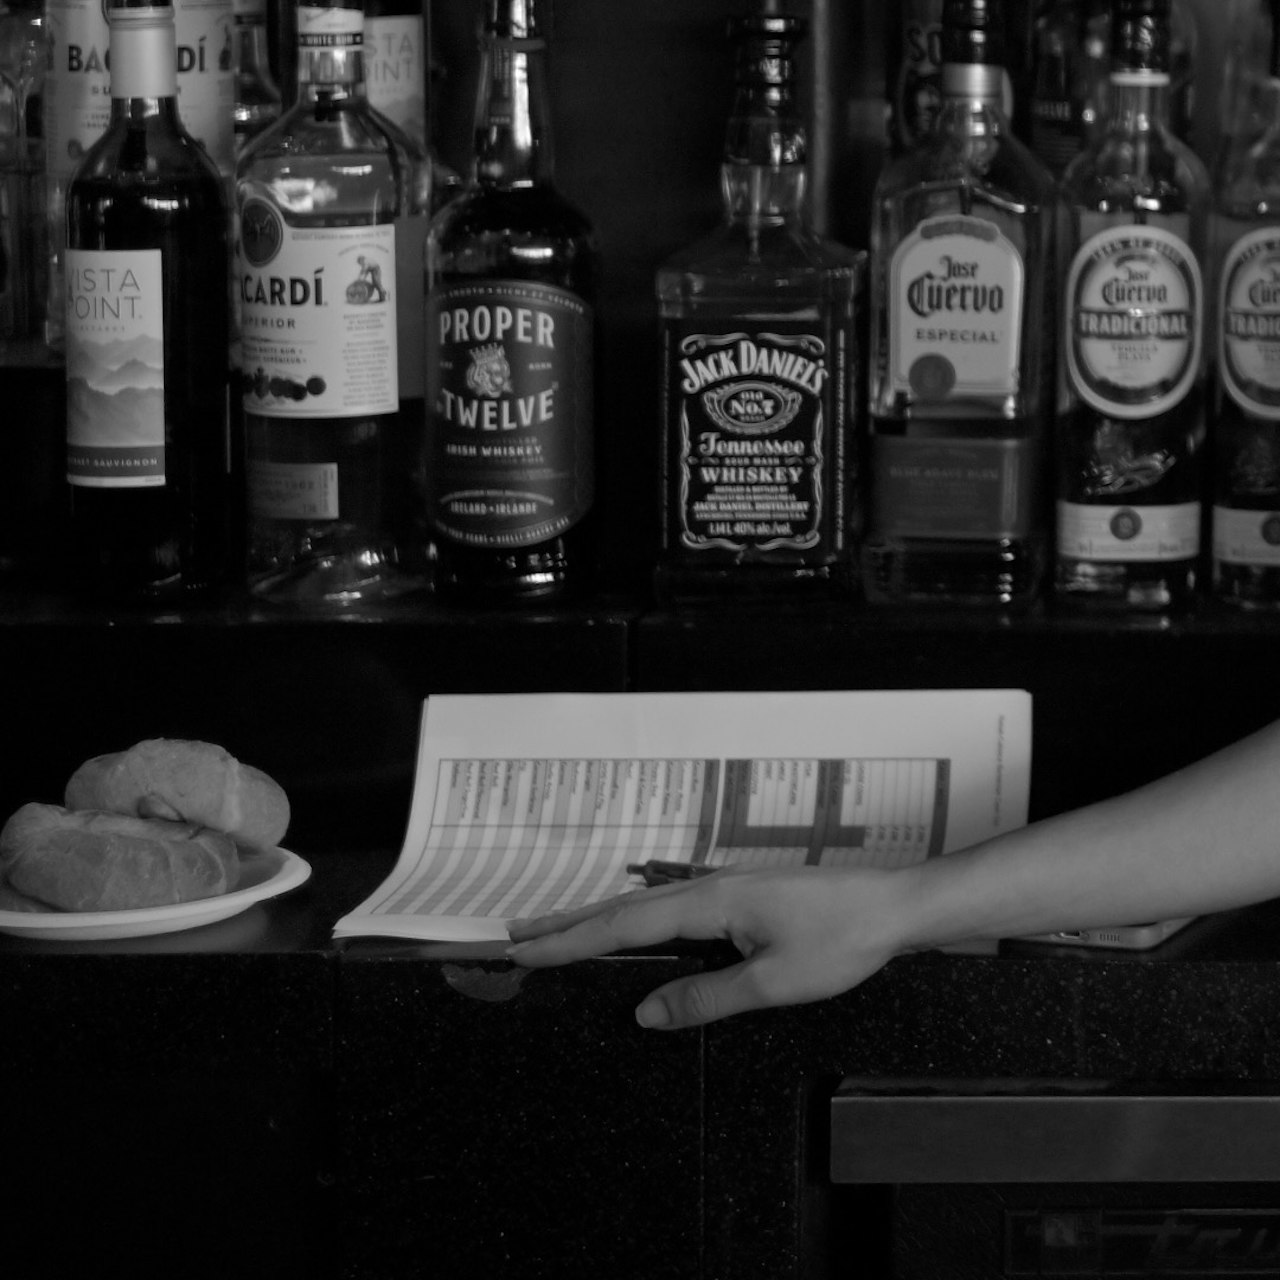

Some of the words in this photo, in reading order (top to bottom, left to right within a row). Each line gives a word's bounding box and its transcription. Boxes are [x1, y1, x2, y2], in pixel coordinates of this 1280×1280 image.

[939, 254, 979, 282] Jose
[907, 271, 1004, 318] Cuervo
[1102, 277, 1167, 305] Cuervo
[440, 305, 555, 348] PROPER
[915, 327, 999, 343] ESPECIAL
[1080, 312, 1188, 335] TRADICIONAL
[679, 349, 739, 394] JACK
[739, 340, 829, 397] DANIEL'S
[441, 388, 555, 432] TWELVE
[481, 445, 542, 457] WHISKEY
[699, 432, 805, 456] Tennessee
[700, 466, 803, 484] WHISKEY
